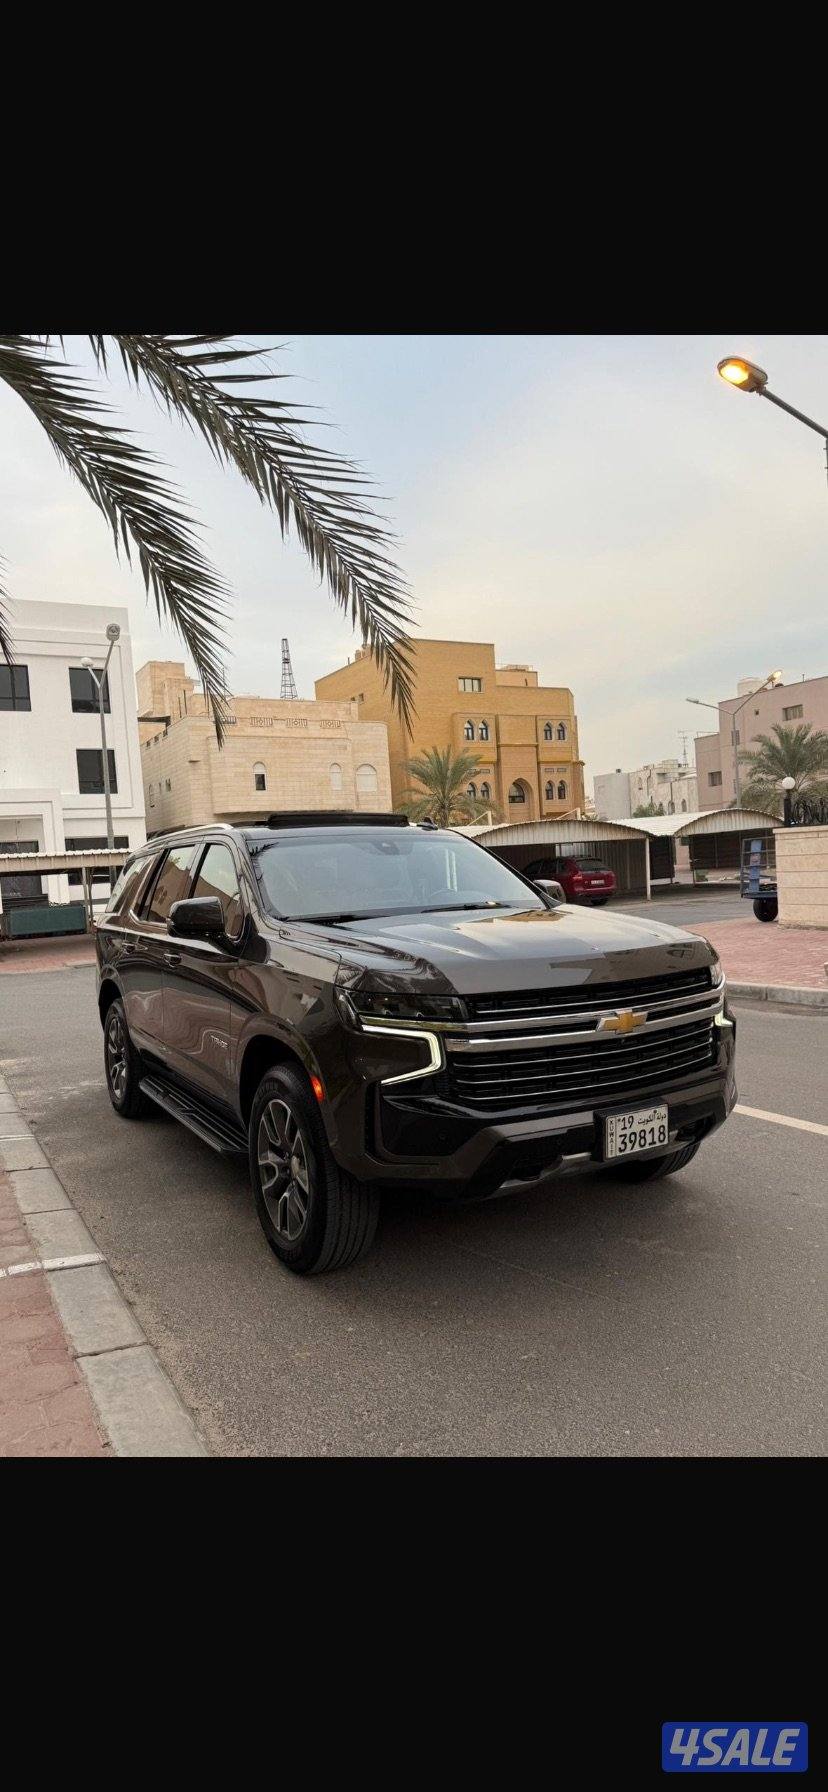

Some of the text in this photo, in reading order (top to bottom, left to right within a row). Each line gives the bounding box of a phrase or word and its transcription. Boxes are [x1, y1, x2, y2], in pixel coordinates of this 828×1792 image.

[620, 1115, 634, 1131] 19
[637, 1112, 656, 1125] الكويت
[618, 1124, 667, 1153] 39818
